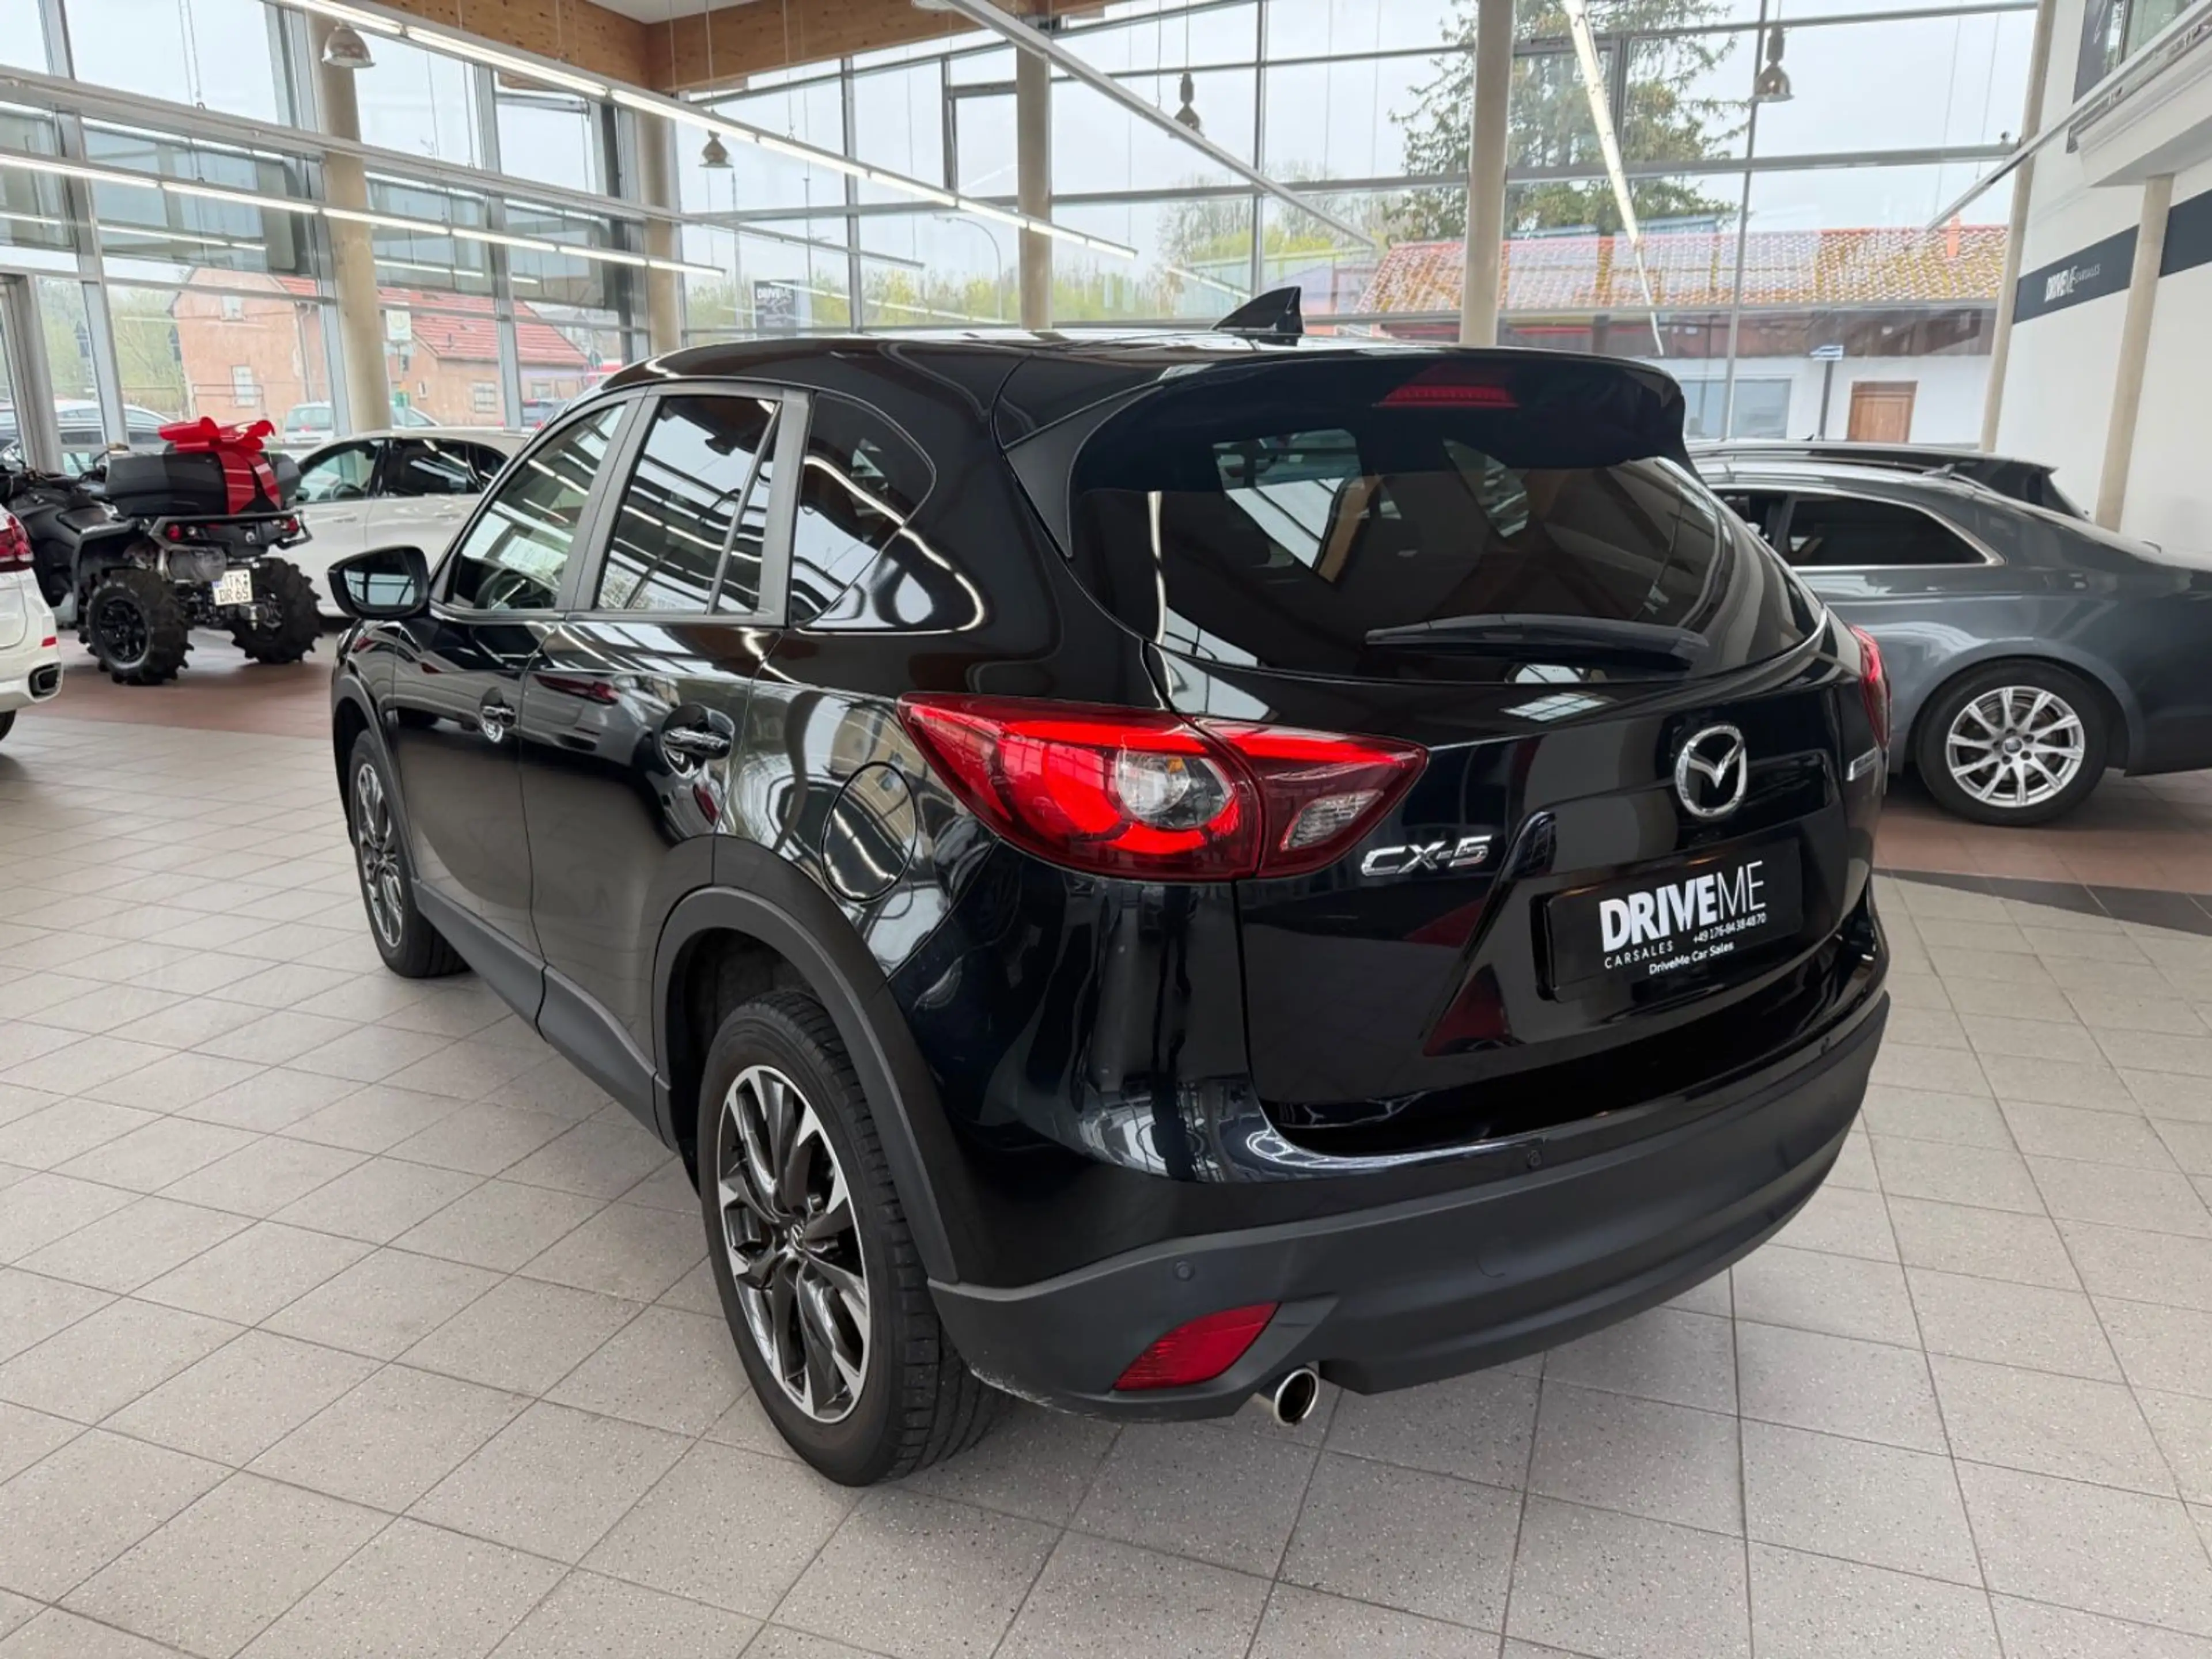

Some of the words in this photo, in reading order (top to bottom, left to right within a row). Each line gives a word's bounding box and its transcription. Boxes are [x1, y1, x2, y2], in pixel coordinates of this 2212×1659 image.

[1361, 835, 1493, 876] CX-5
[1604, 940, 1674, 969] CARSALES
[1649, 955, 1691, 975] DriveMe
[1692, 950, 1708, 962] Car
[1710, 942, 1734, 957] Sales
